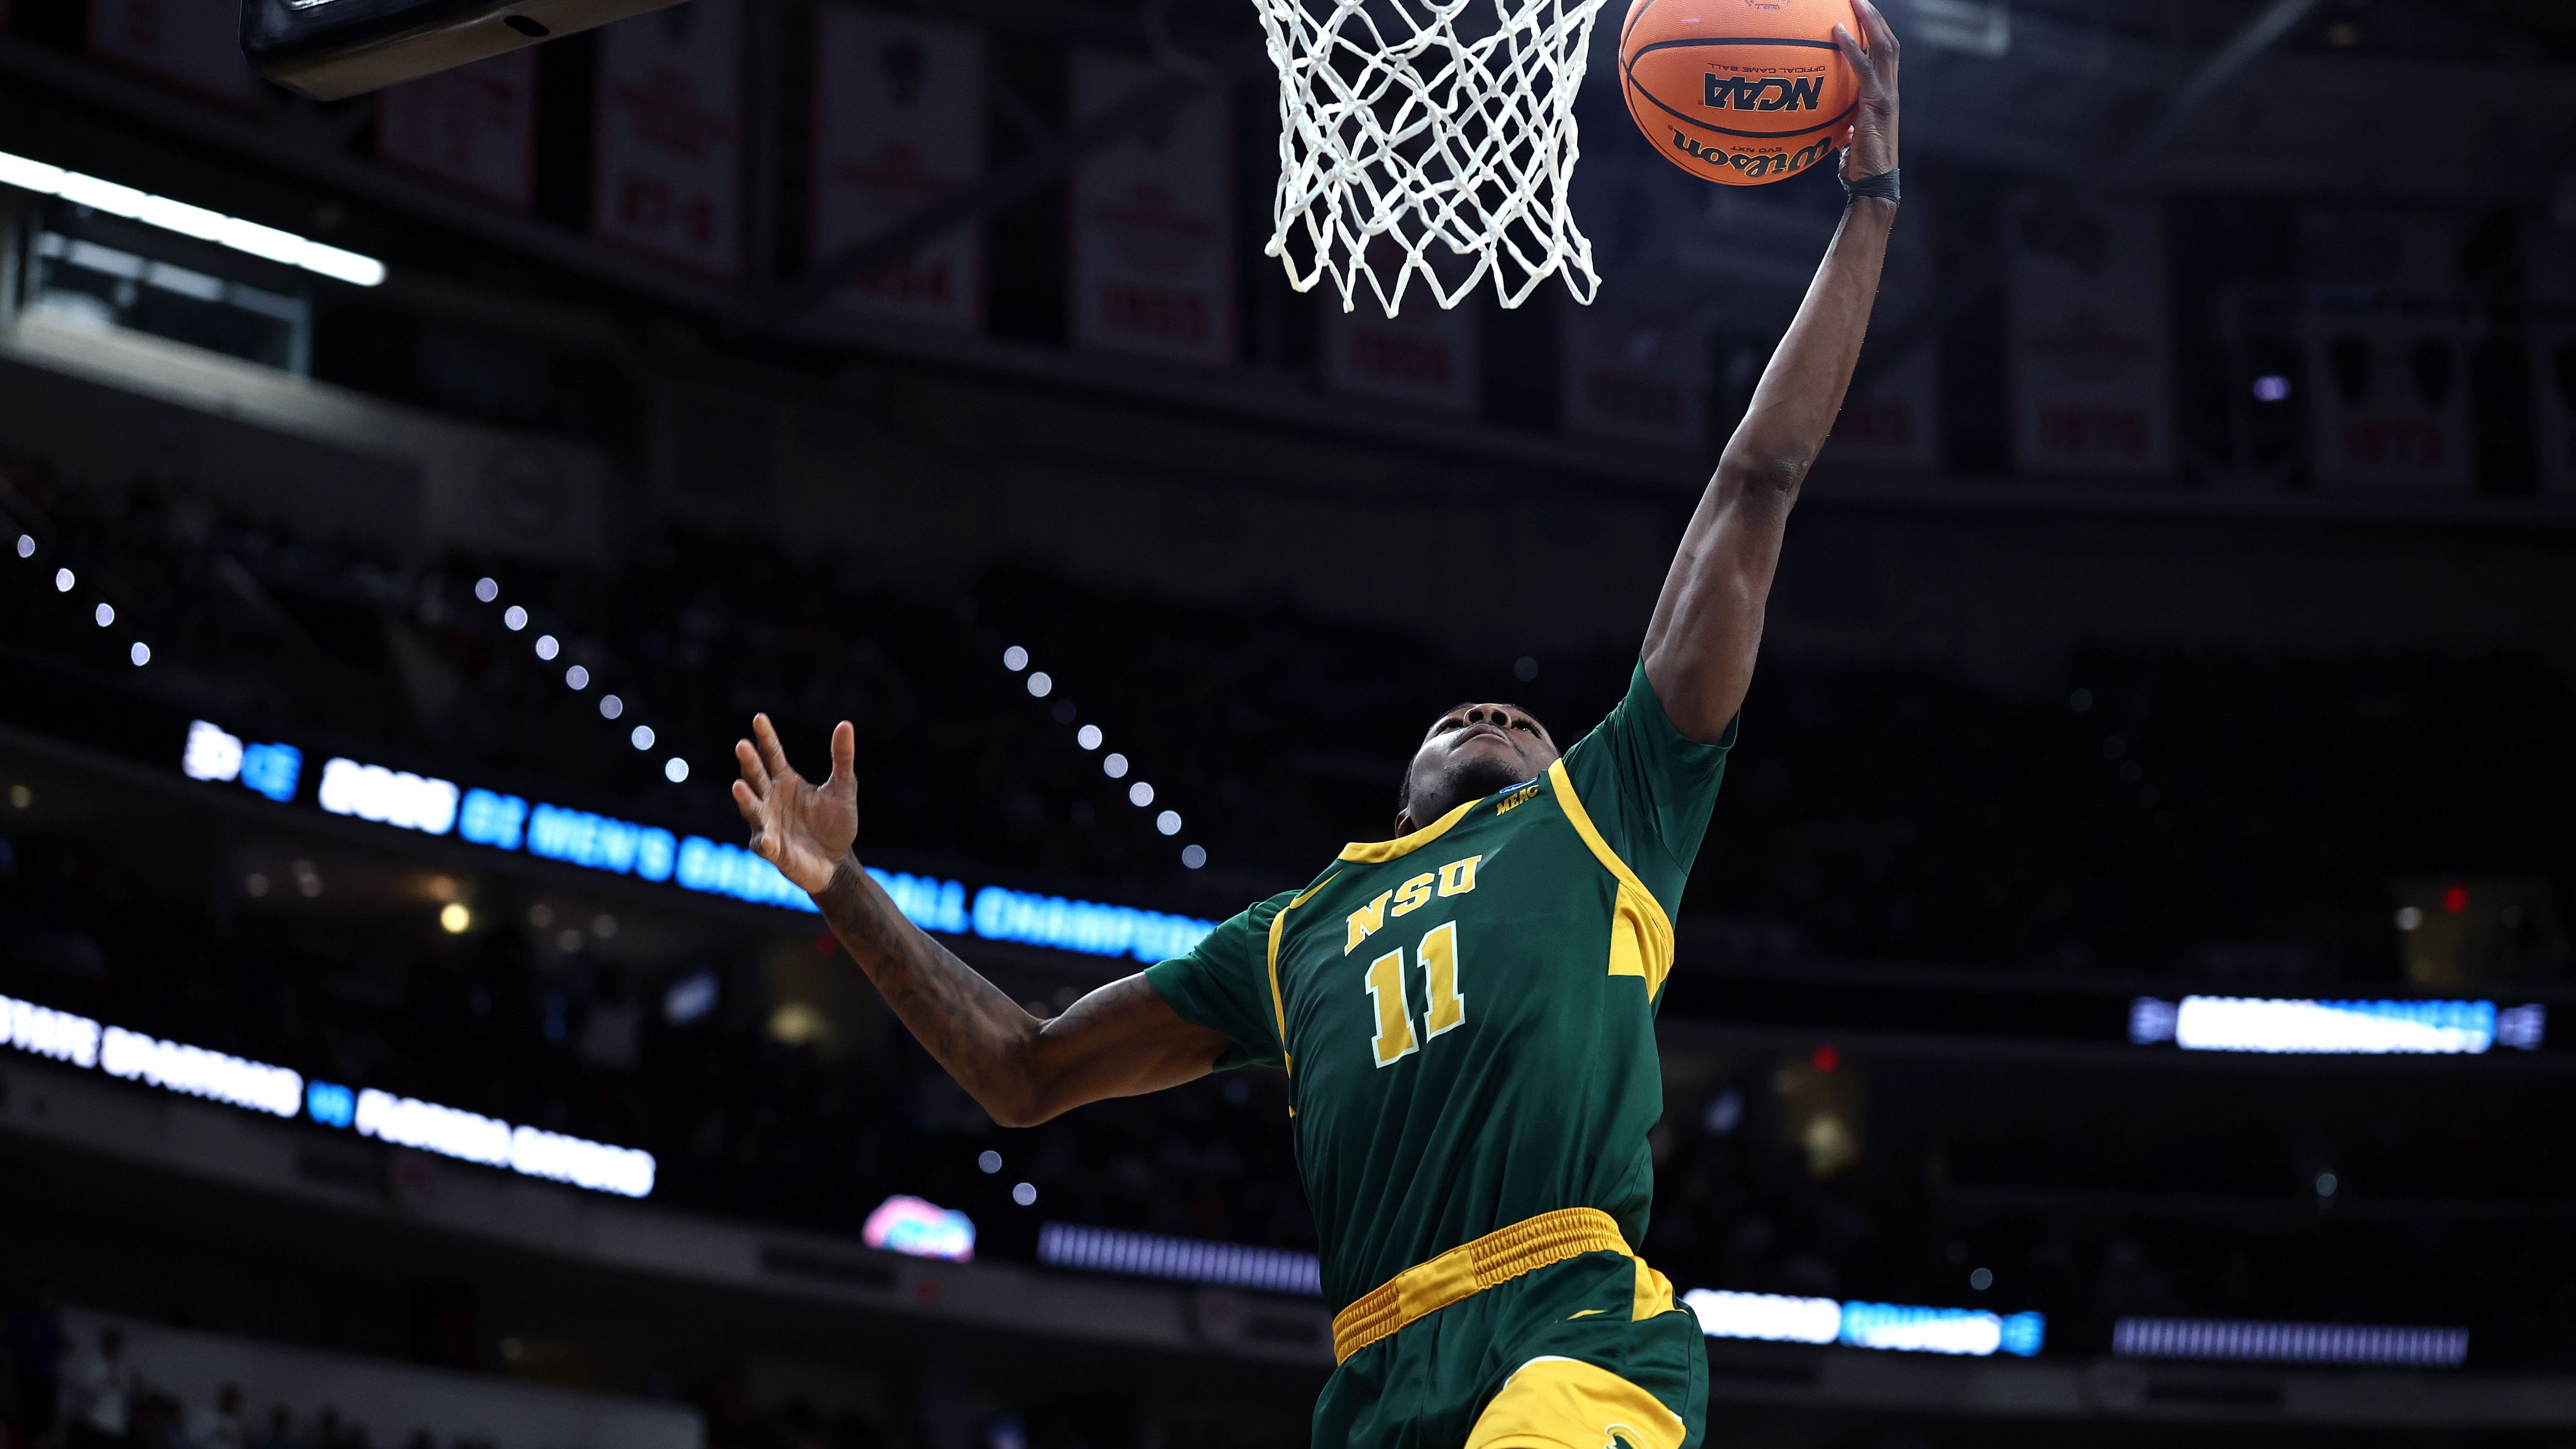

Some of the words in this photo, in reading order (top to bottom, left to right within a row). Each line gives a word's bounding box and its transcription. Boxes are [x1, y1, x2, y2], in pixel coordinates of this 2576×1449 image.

[1707, 63, 1738, 71] BALL
[1779, 65, 1825, 74] OFFICIAL
[1704, 72, 1825, 112] NCAA
[1673, 128, 1832, 178] Wilson
[1496, 784, 1539, 816] MEAC
[1344, 854, 1482, 956] NSU
[1364, 920, 1466, 1069] 11
